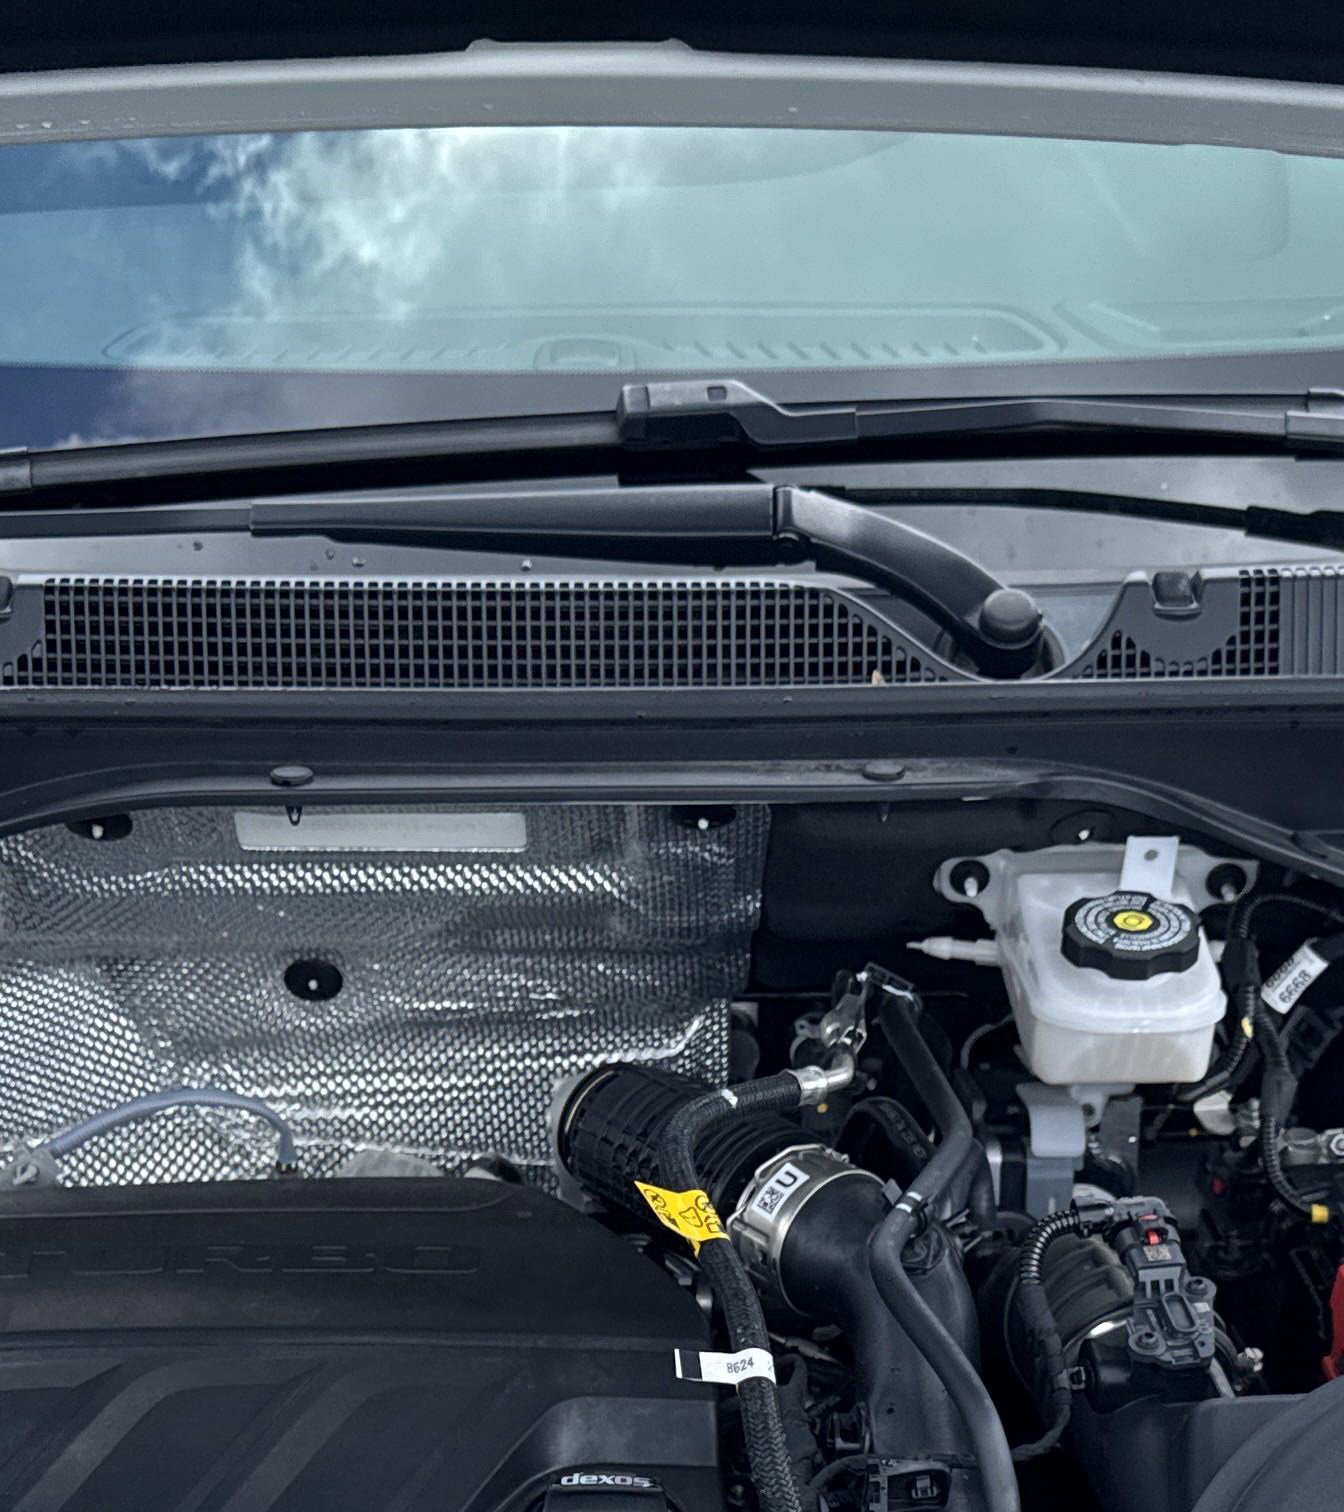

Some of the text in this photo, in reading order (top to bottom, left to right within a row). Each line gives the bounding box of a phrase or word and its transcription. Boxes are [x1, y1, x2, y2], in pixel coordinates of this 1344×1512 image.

[775, 1170, 798, 1188] U
[726, 1357, 755, 1374] 8624
[560, 1472, 654, 1488] dexos
